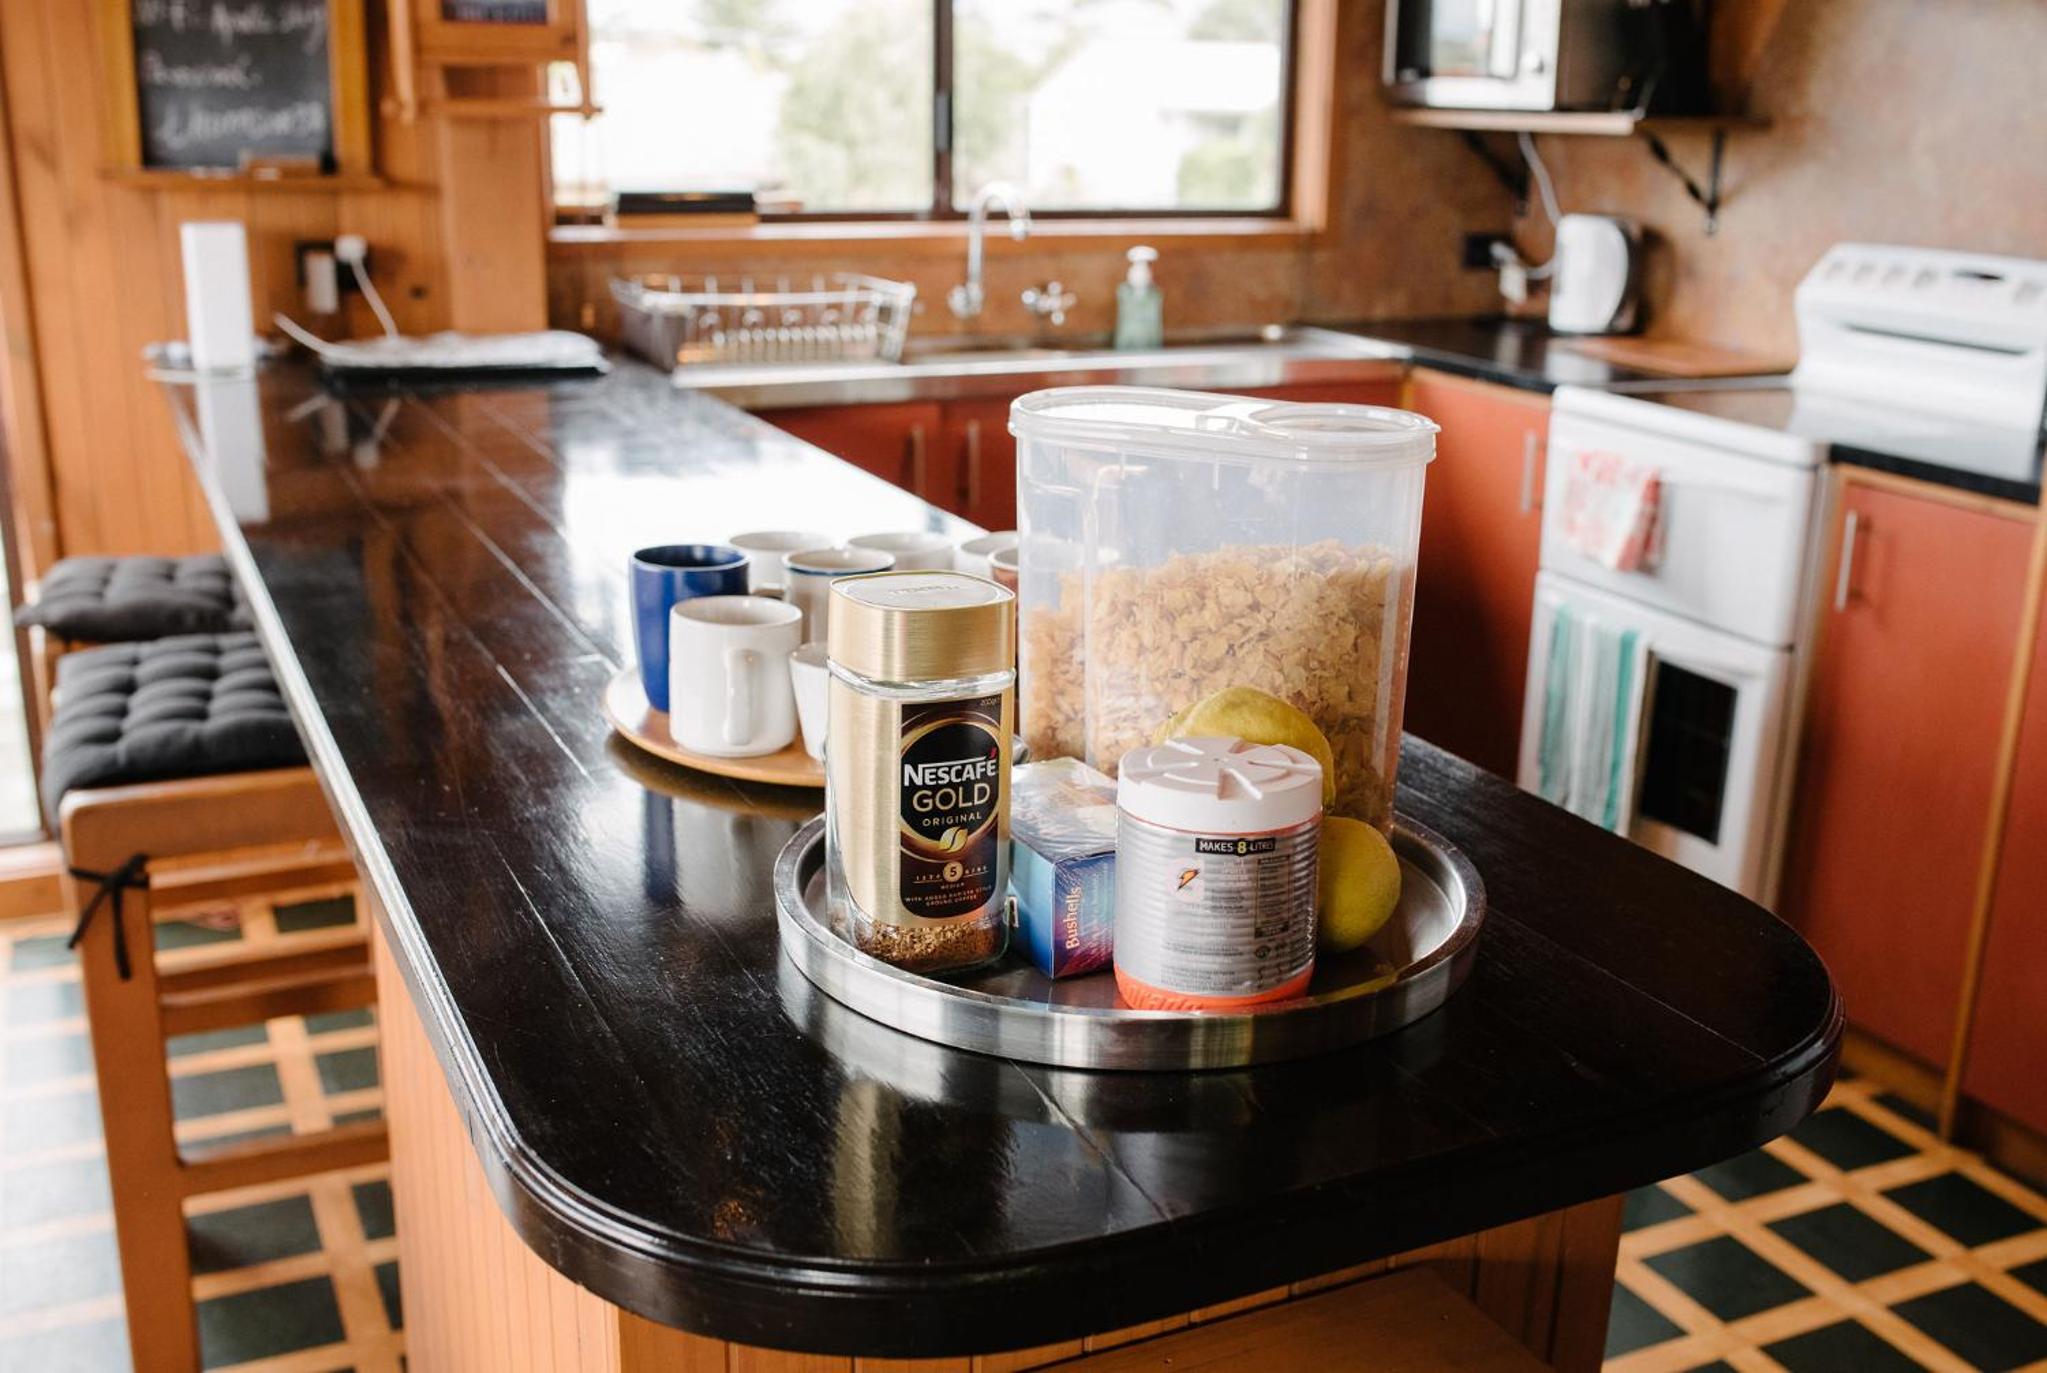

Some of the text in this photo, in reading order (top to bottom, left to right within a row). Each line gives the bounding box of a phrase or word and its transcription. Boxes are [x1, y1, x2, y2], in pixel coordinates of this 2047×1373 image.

[903, 747, 997, 787] NESCAFÉ
[912, 782, 991, 812] GOLD
[922, 811, 982, 827] ORIGINAL
[1199, 840, 1234, 852] MAKES
[1237, 841, 1247, 854] 8
[1063, 886, 1082, 950] Bushells
